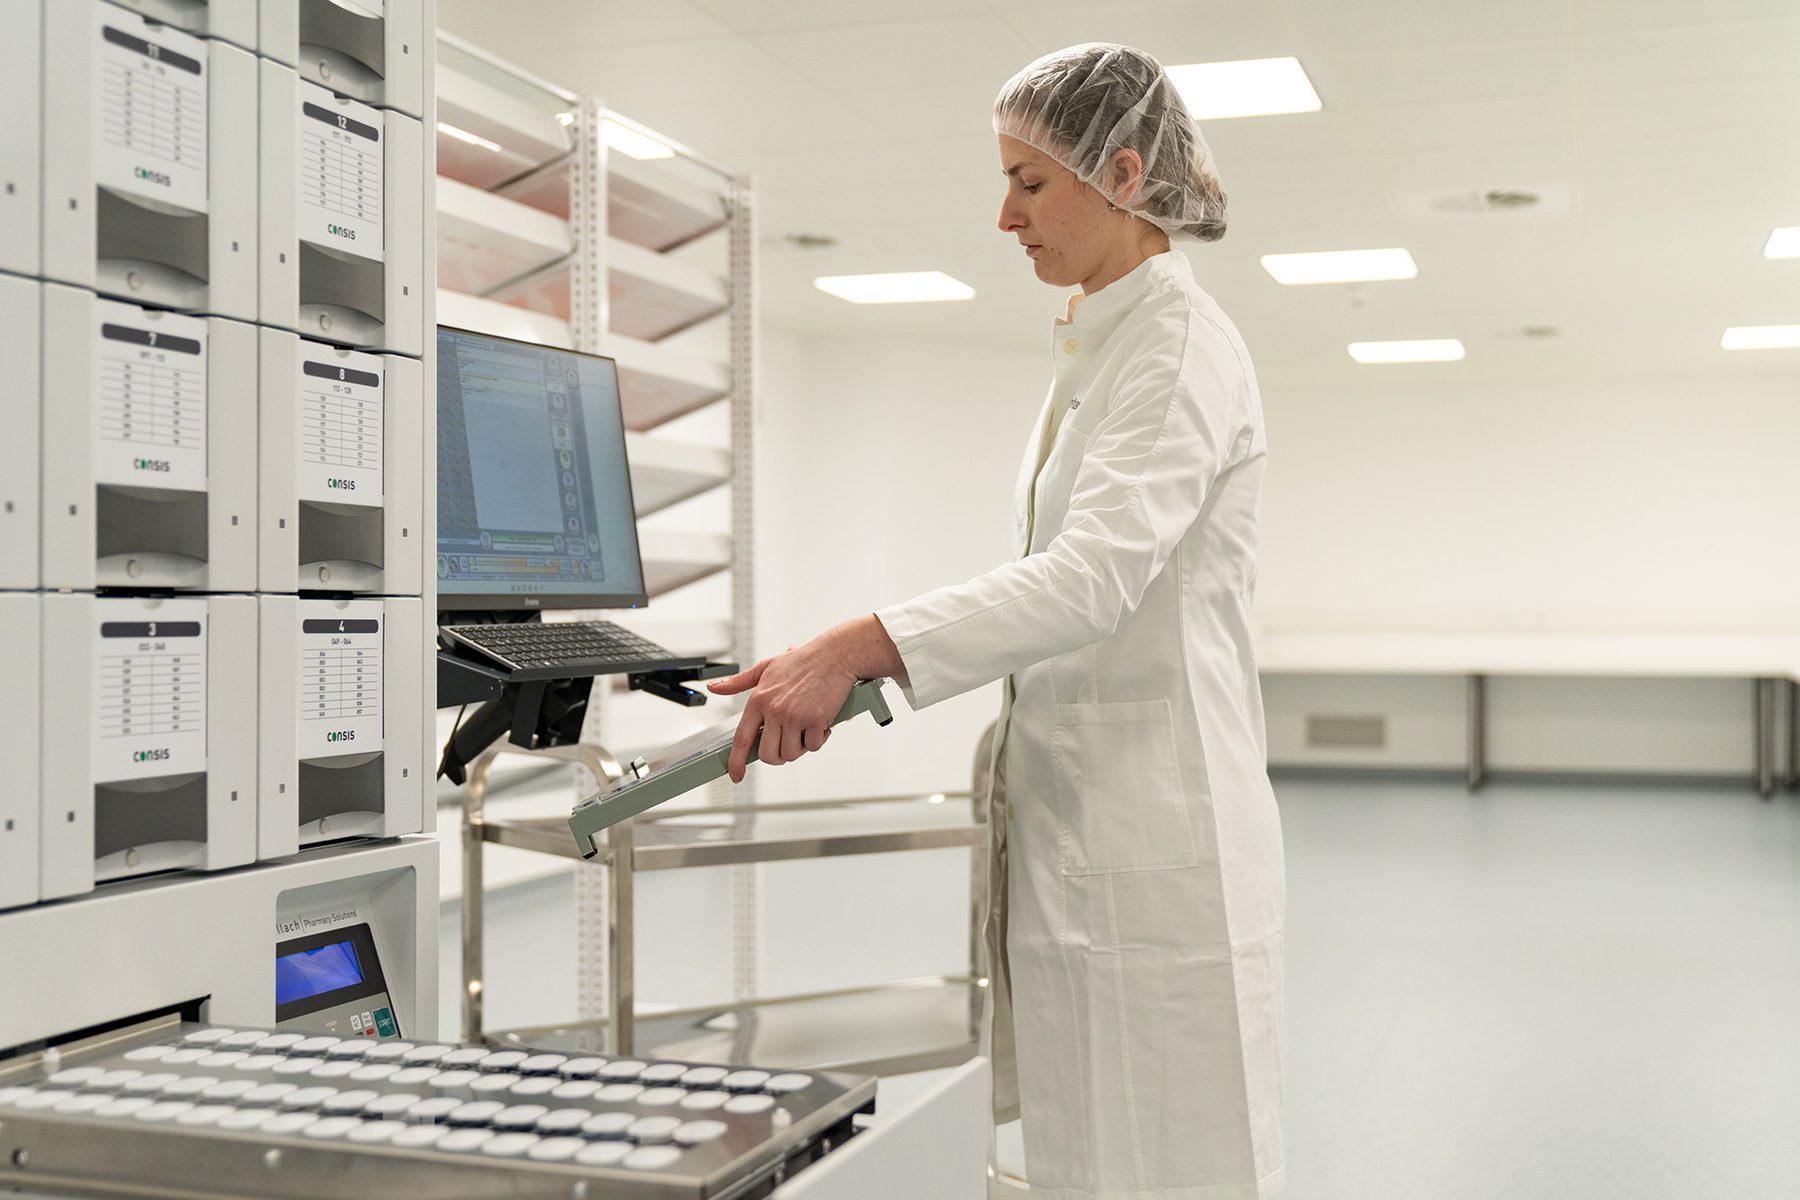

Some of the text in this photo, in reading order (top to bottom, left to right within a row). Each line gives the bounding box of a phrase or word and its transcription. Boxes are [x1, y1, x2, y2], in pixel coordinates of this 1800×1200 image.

[337, 116, 347, 129] 12
[148, 332, 157, 345] 7
[340, 368, 345, 380] 8
[148, 623, 156, 636] 3
[339, 620, 344, 632] 4
[304, 916, 332, 928] Pharmacy
[332, 911, 357, 922] Solutions
